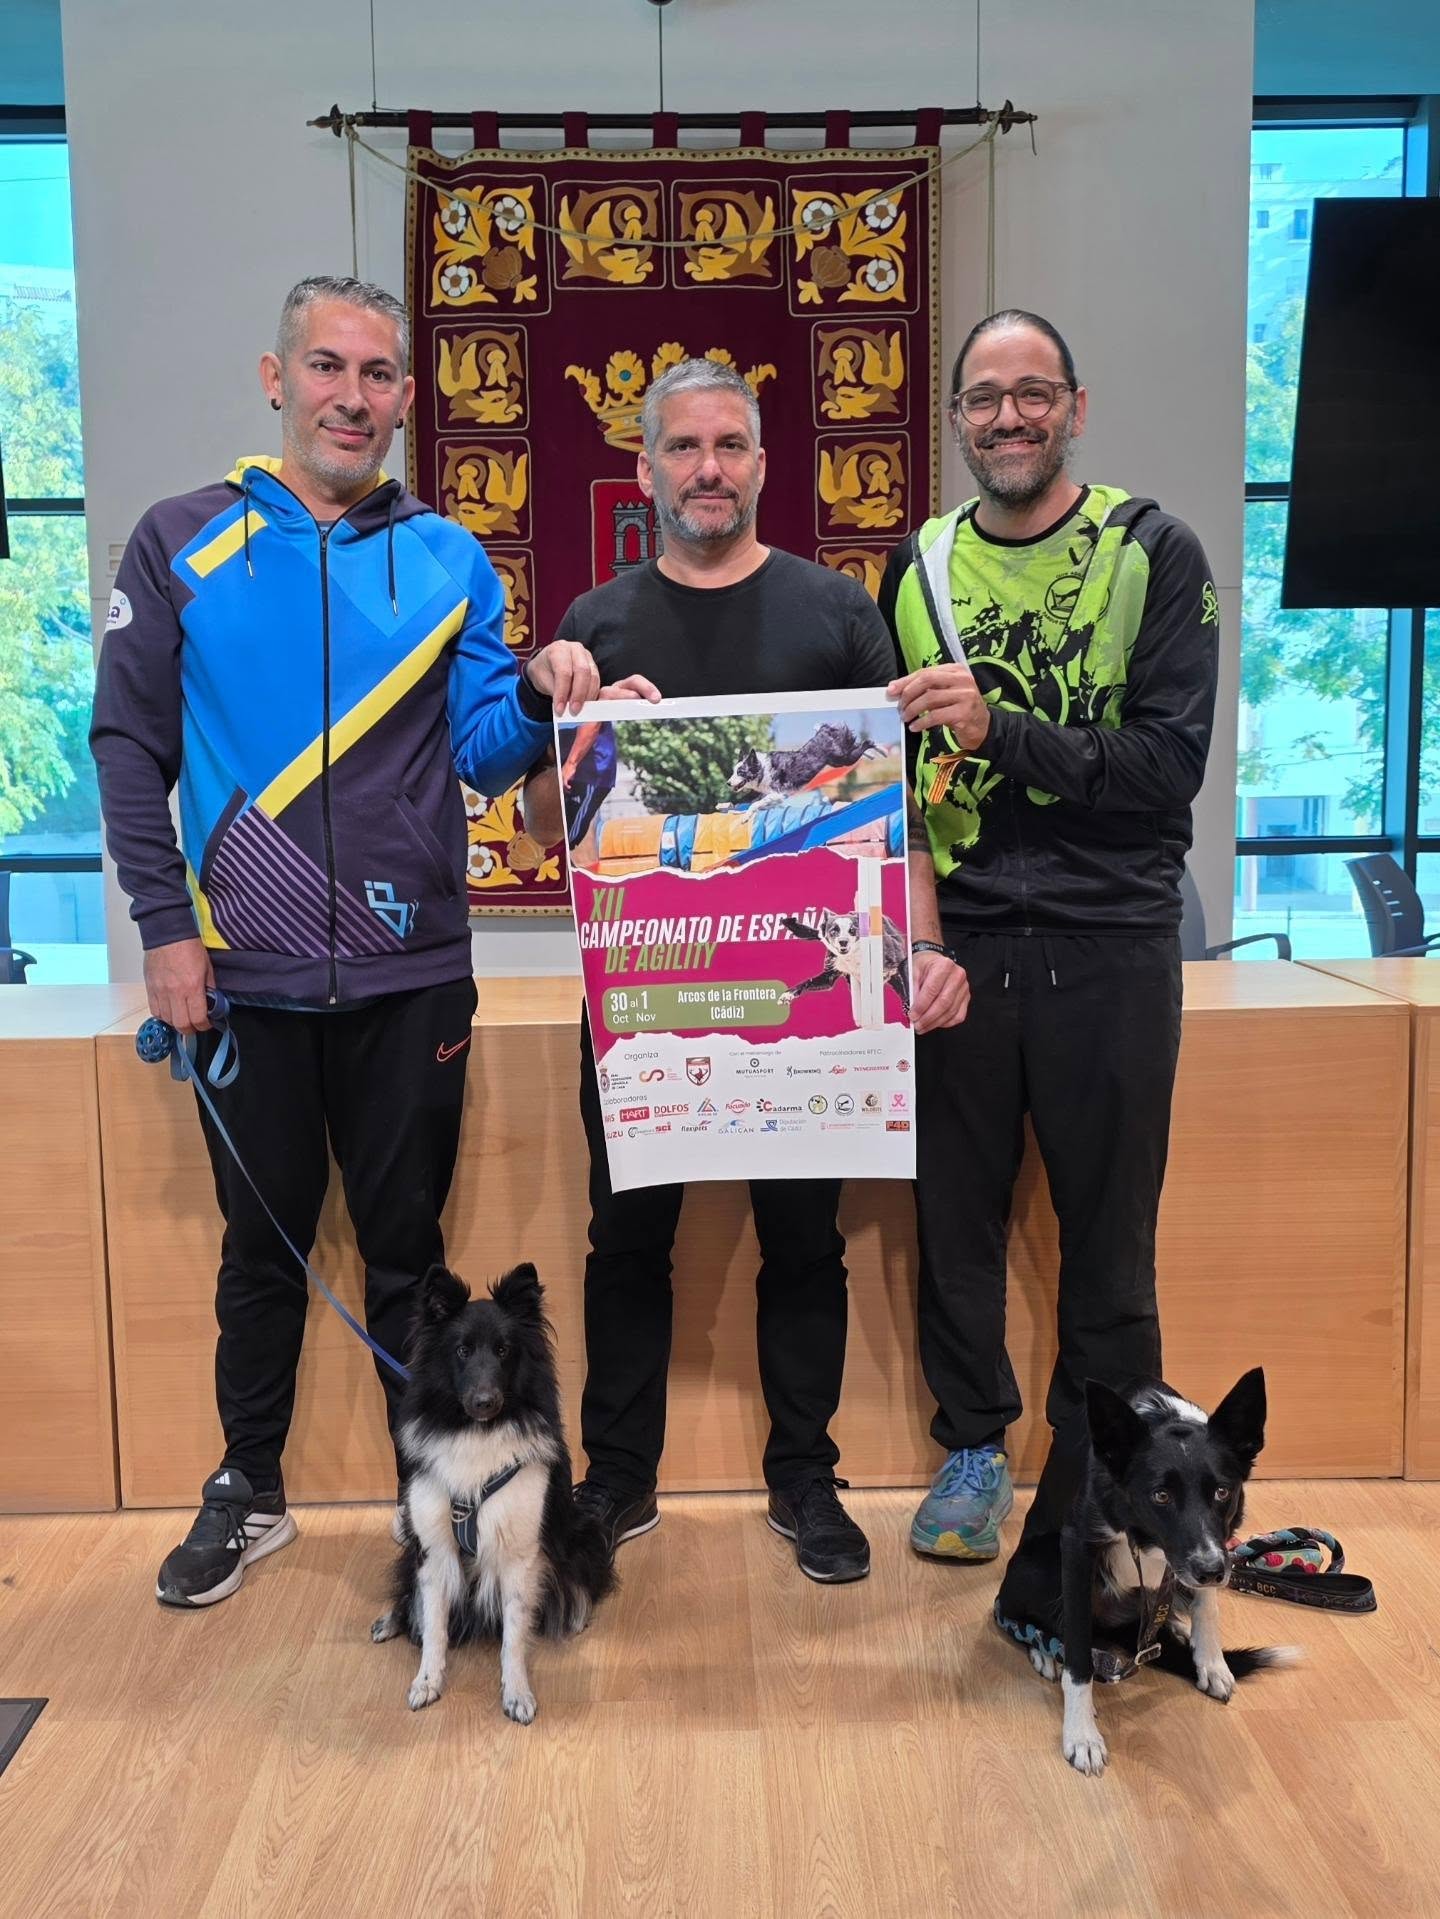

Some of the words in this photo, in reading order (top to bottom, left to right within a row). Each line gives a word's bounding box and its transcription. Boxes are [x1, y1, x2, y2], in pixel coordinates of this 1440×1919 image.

[589, 887, 625, 921] XII
[581, 916, 712, 949] CAMPEONATO
[716, 914, 745, 943] DE
[604, 945, 632, 974] DE
[634, 942, 717, 972] AGILITY
[610, 992, 628, 1012] 30
[630, 998, 639, 1008] al
[641, 990, 648, 1009] 1
[677, 990, 706, 1003] Arcos
[707, 989, 720, 1001] de
[722, 989, 732, 1001] la
[733, 988, 776, 1001] Frontera
[613, 1013, 629, 1024] Oct
[636, 1012, 656, 1023] Nov
[624, 1051, 659, 1061] Organiza
[654, 1103, 689, 1115] DOLFOS
